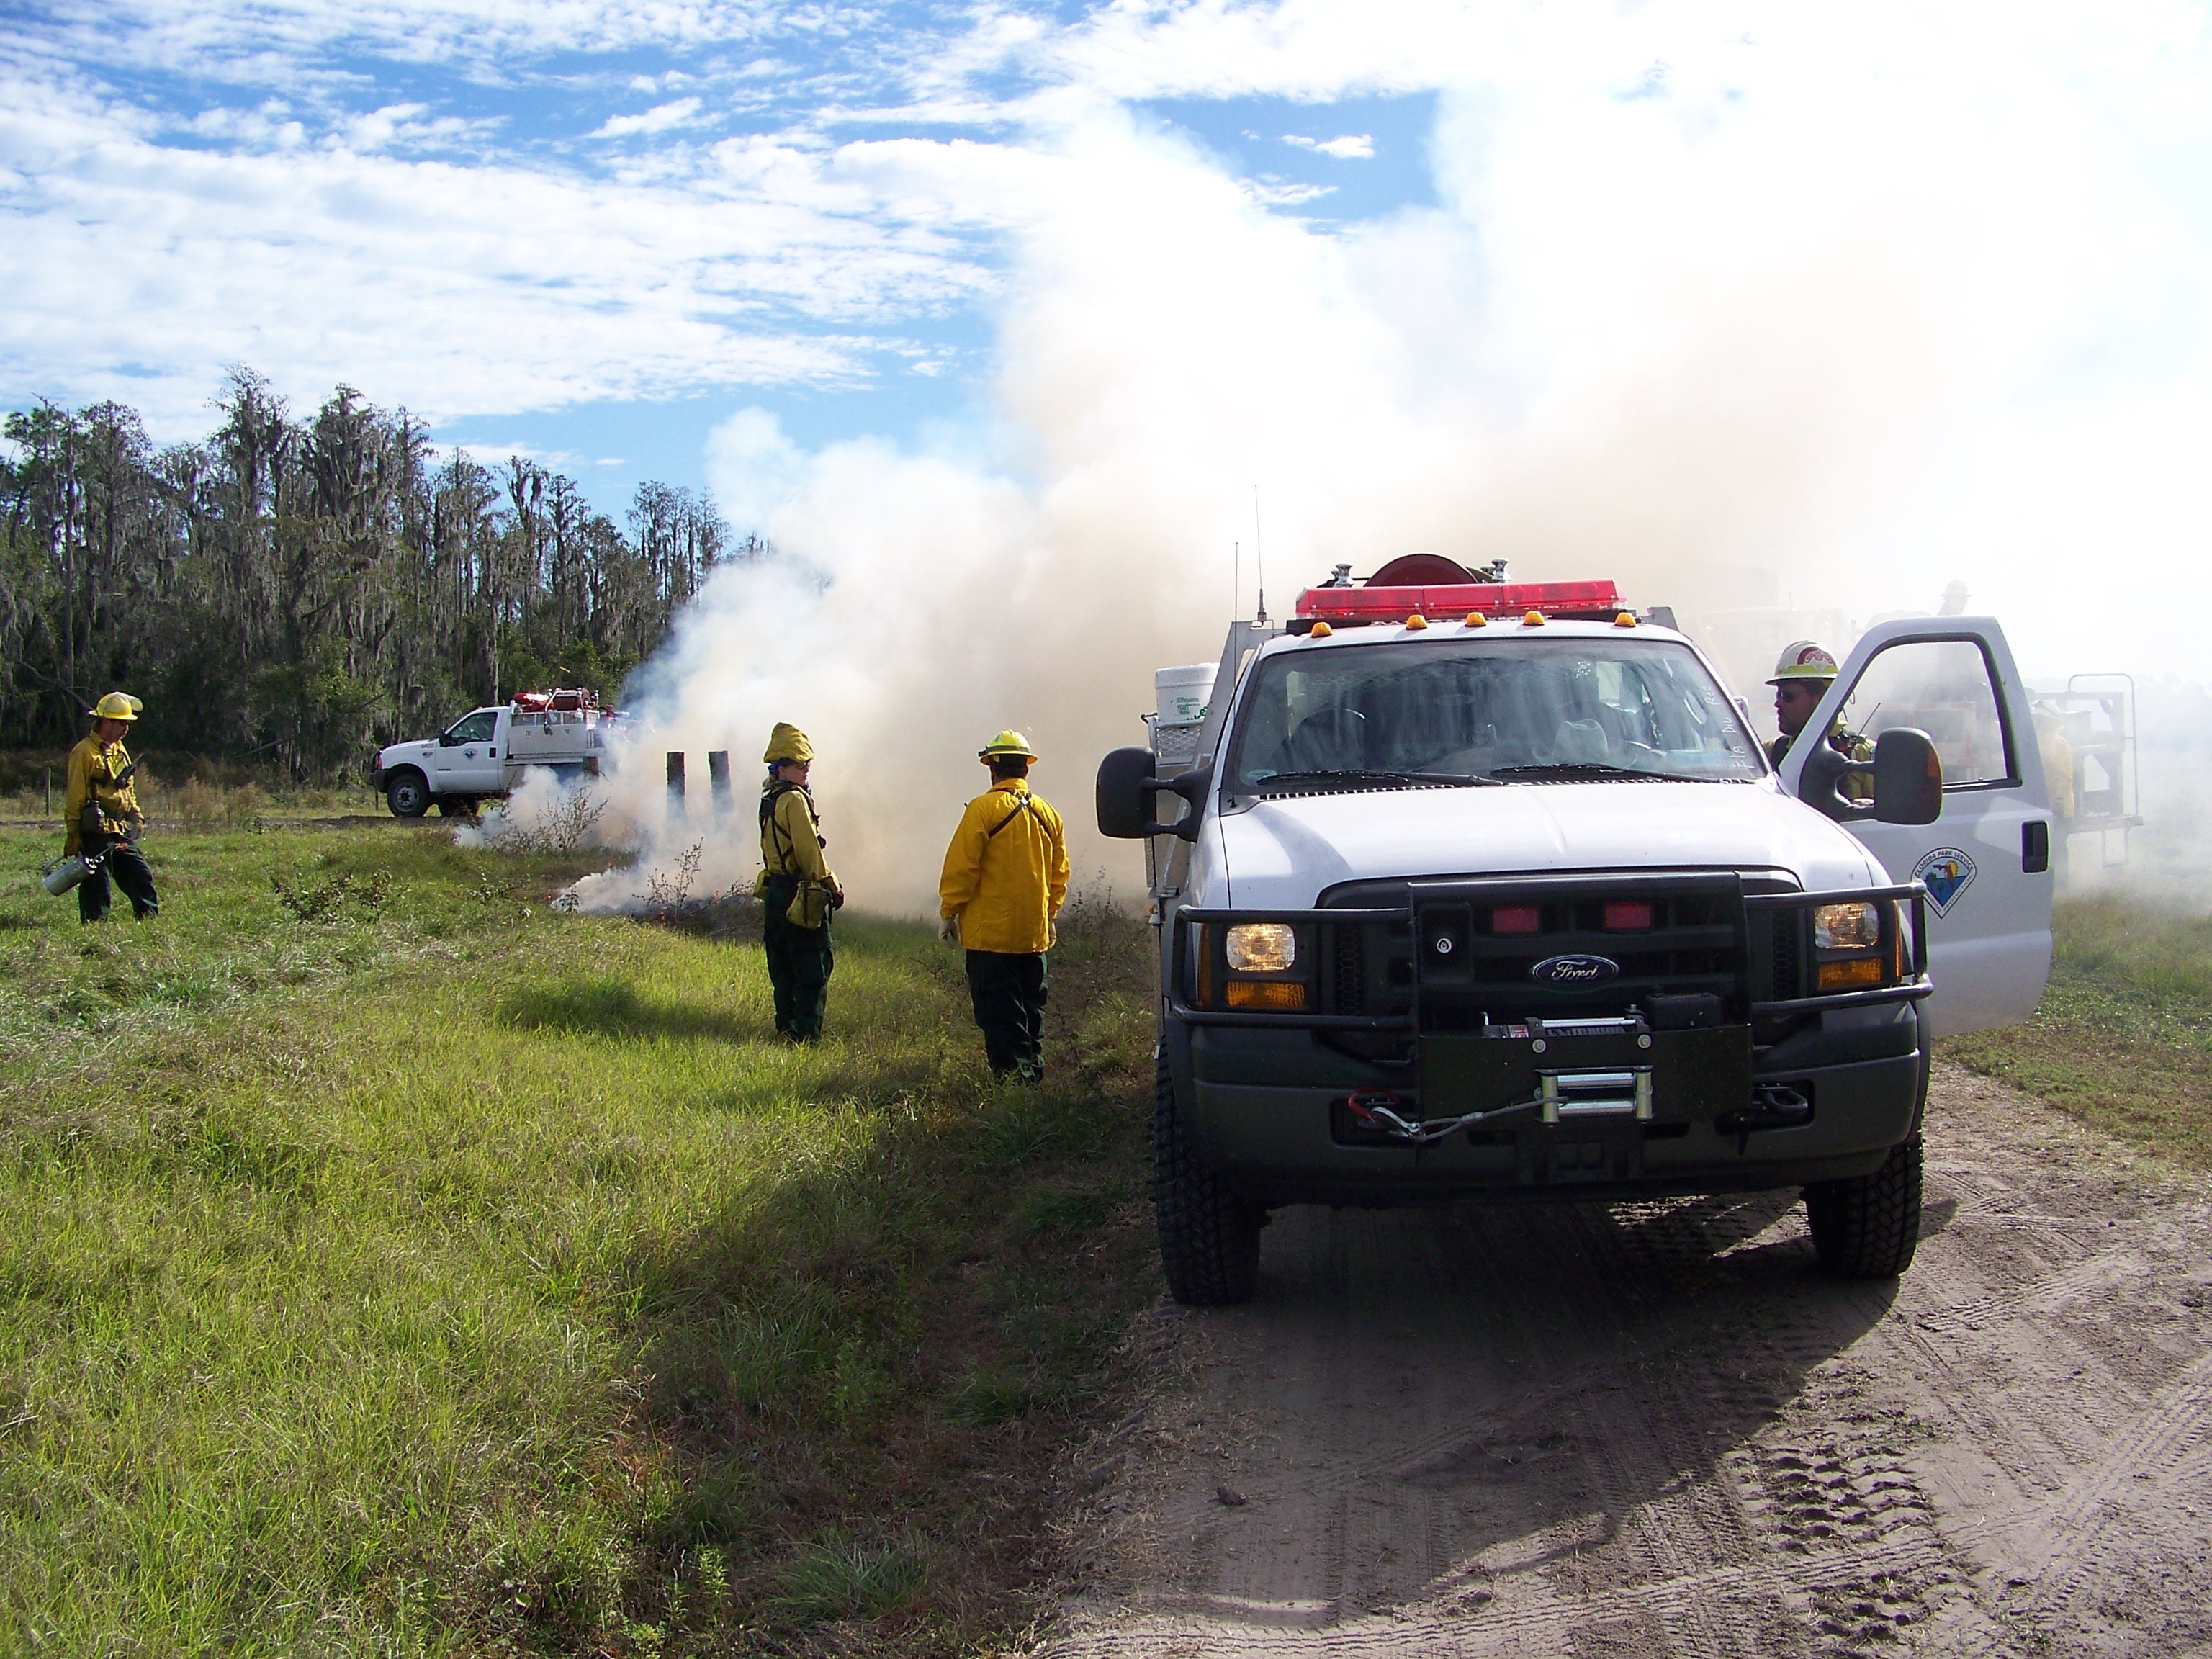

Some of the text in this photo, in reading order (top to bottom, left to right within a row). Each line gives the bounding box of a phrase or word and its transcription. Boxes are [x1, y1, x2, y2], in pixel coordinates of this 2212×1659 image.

[1914, 853, 1937, 877] FLORIDA
[1954, 852, 1974, 871] SERVICE
[1551, 960, 1600, 980] Ford
